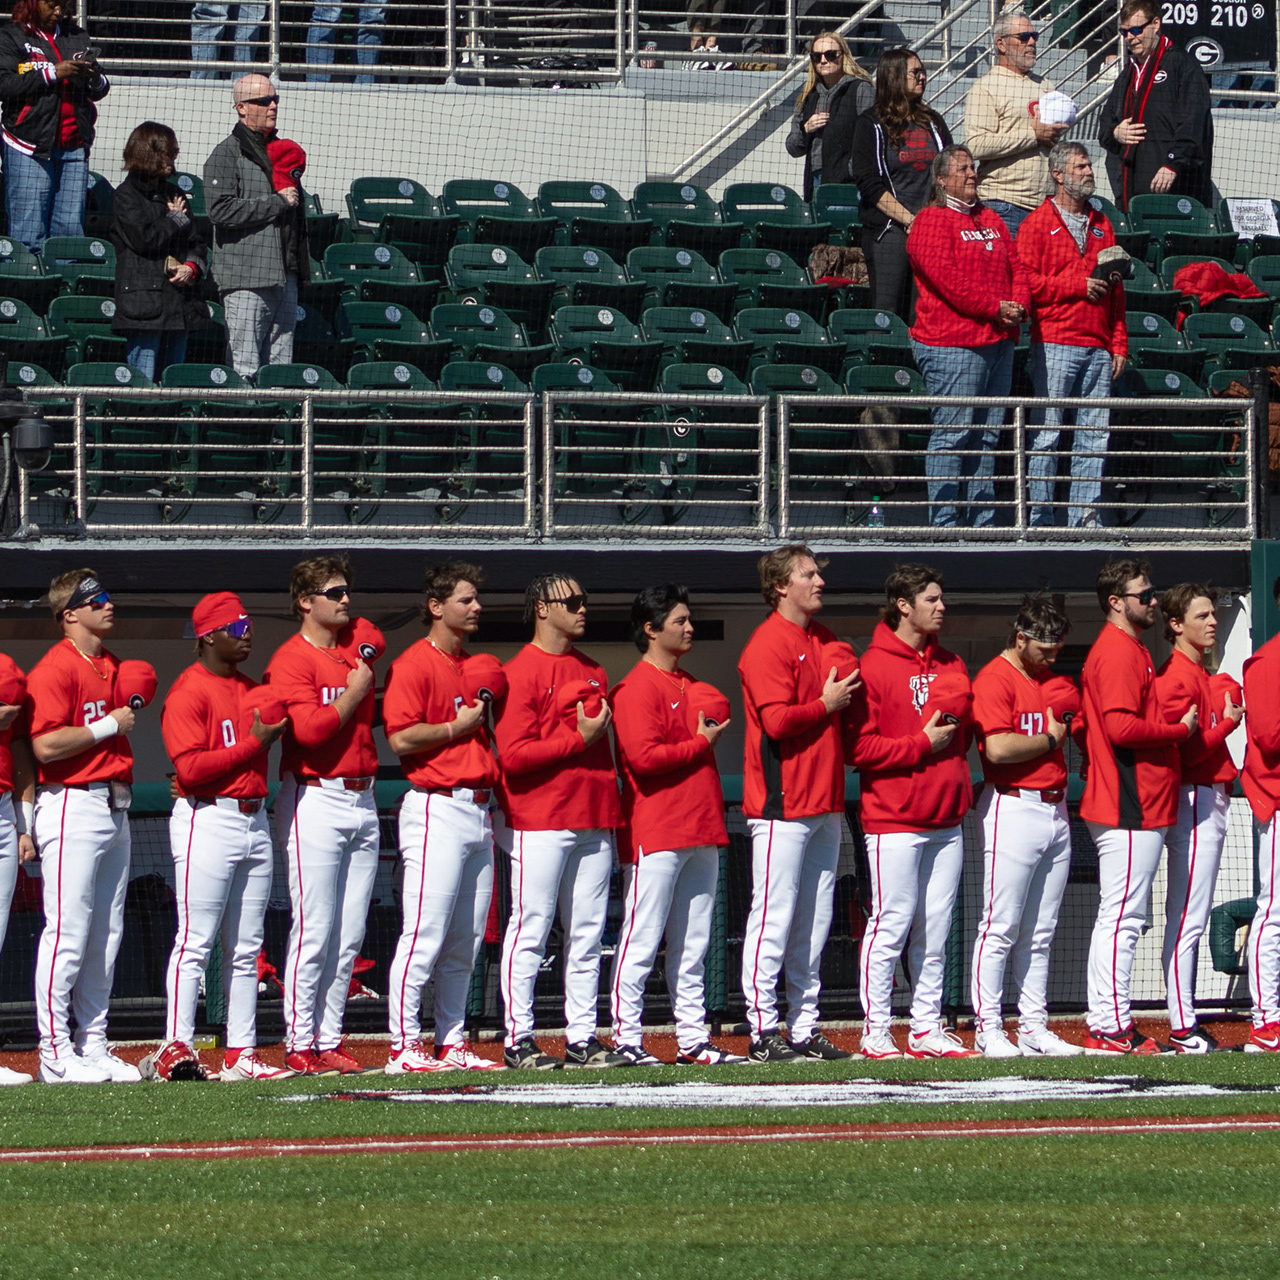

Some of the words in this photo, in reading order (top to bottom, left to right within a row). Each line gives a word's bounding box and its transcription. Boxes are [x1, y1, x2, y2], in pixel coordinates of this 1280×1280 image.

[1162, 3, 1198, 25] 209
[1211, 5, 1248, 27] 210
[83, 700, 106, 727] 25
[1021, 713, 1043, 736] 47
[222, 719, 236, 747] 0
